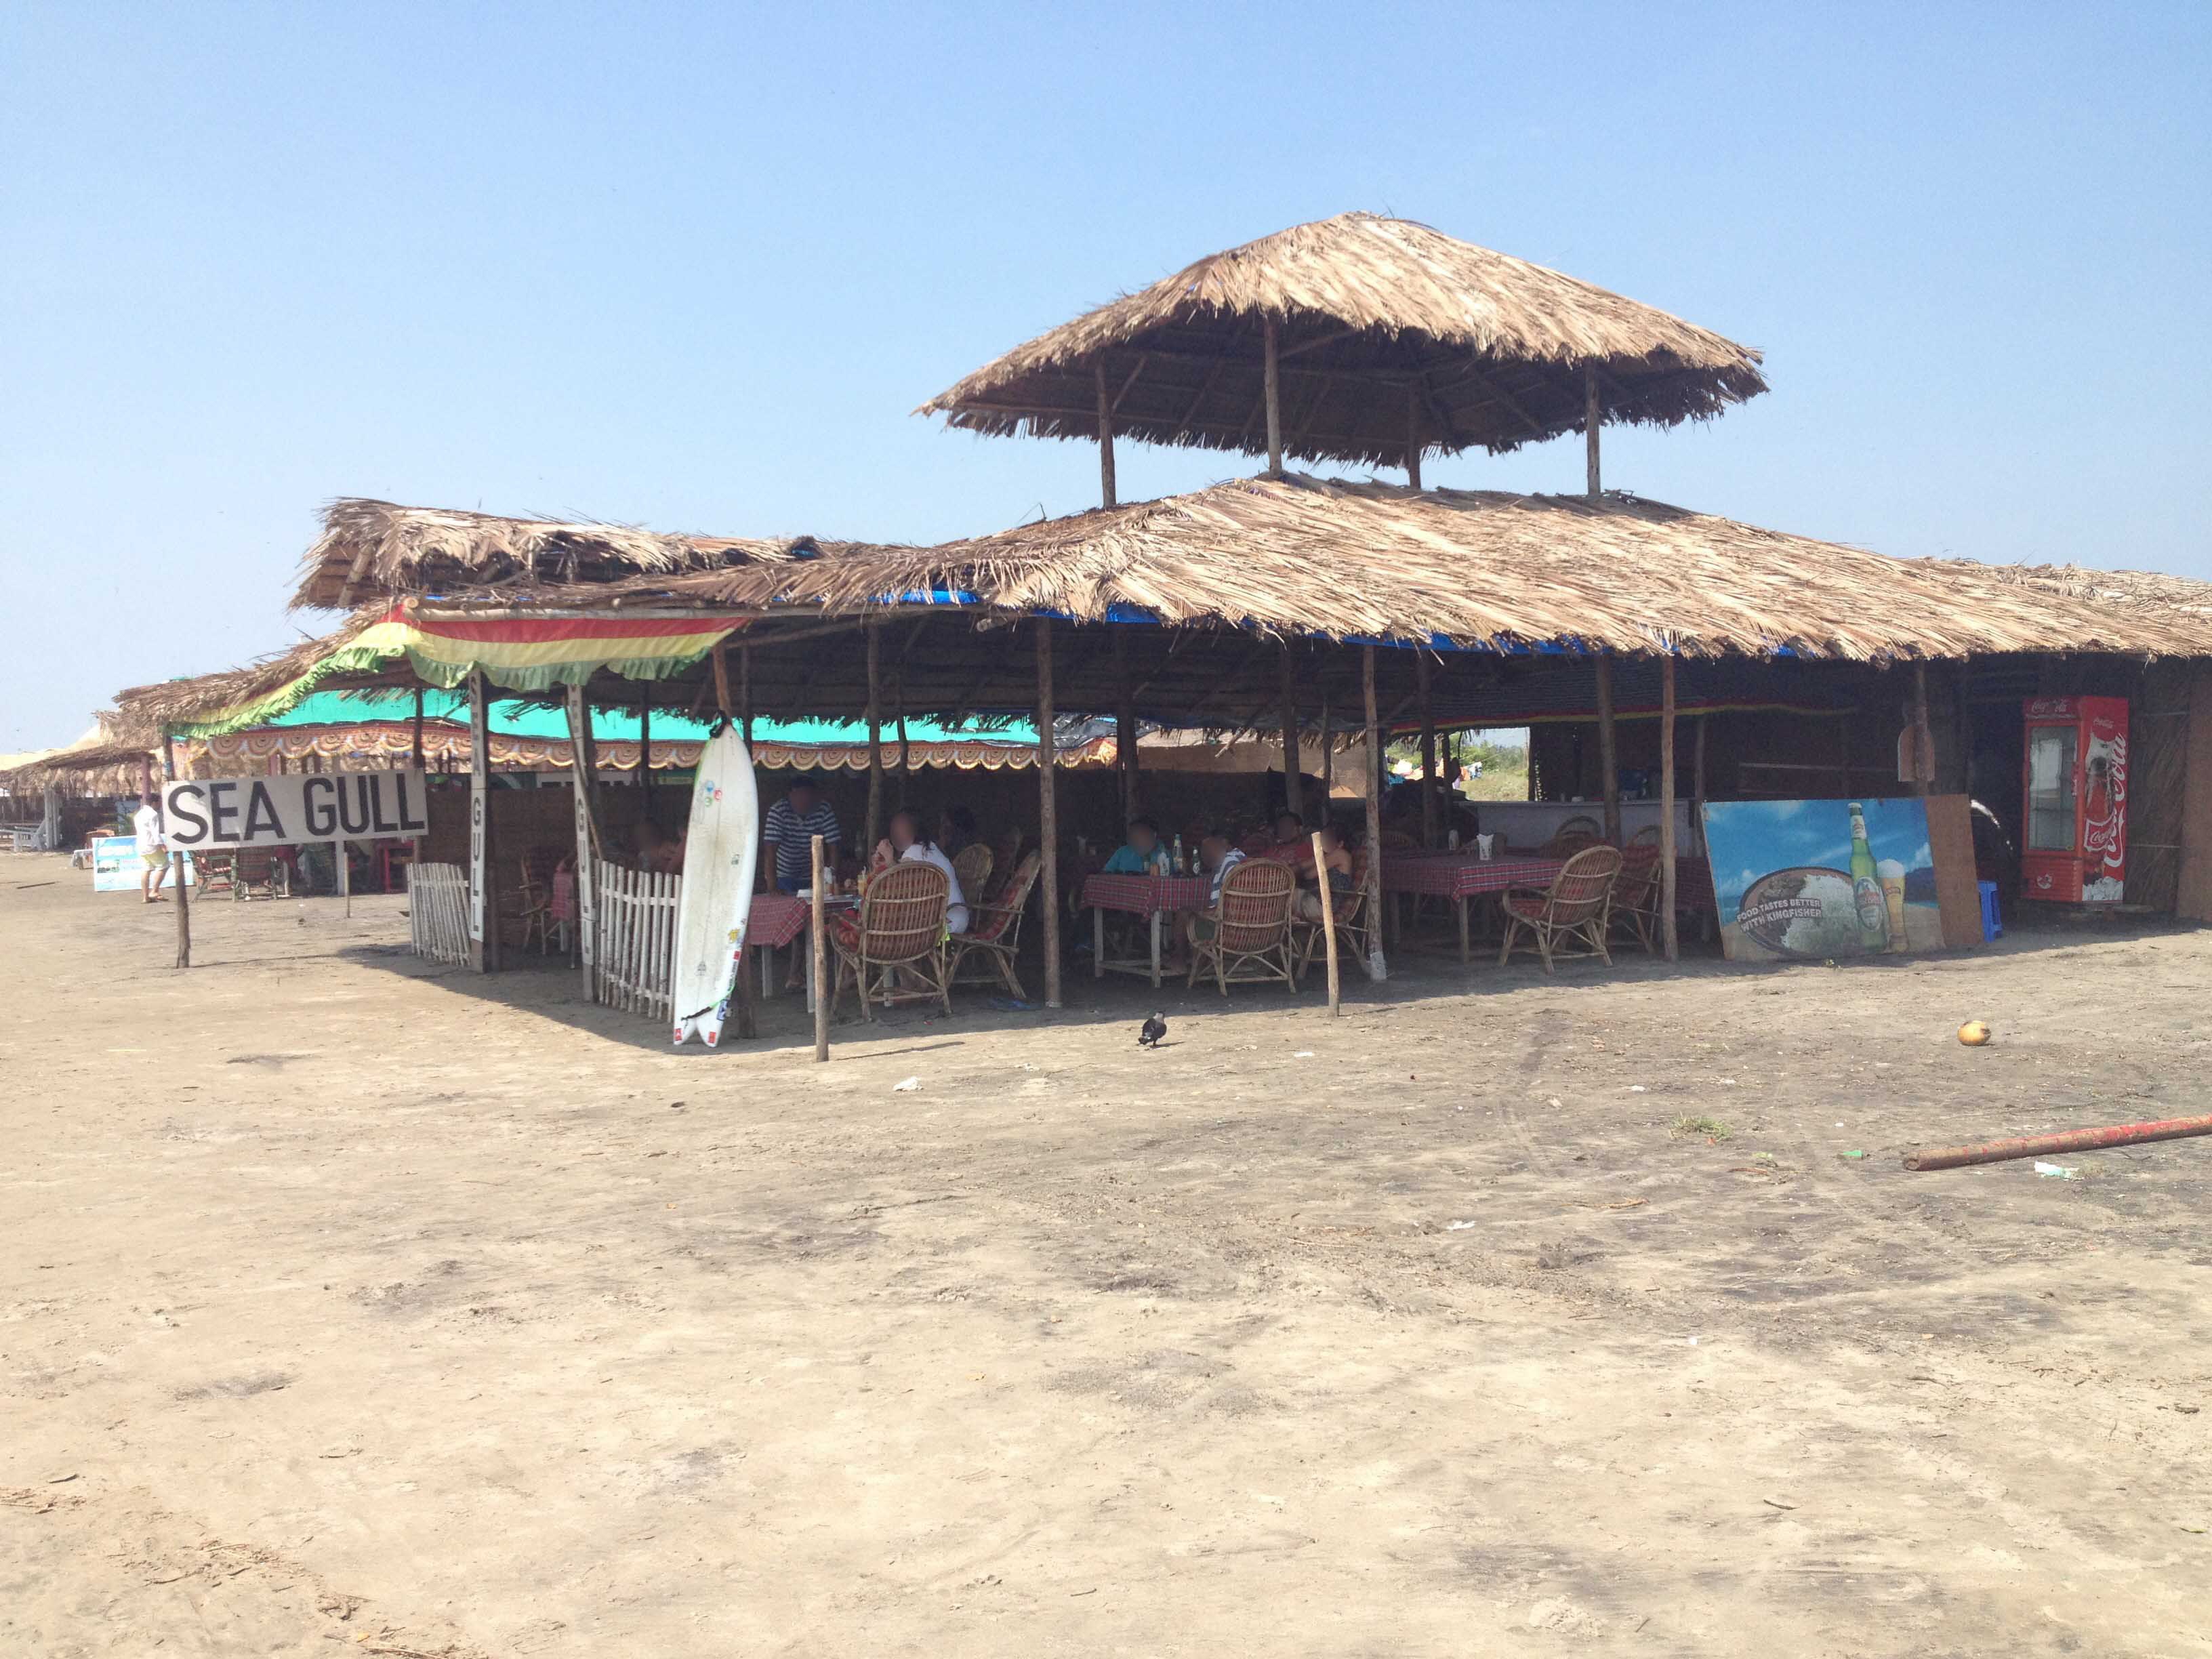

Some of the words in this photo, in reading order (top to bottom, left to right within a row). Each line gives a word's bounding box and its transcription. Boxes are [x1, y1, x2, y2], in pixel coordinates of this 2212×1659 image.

[168, 781, 286, 844] SEA
[303, 773, 426, 837] GULL
[472, 796, 482, 933] GULL
[1737, 907, 1759, 922] FOOD
[1759, 899, 1789, 912] TASTES
[1790, 899, 1821, 907] BETTER
[1740, 915, 1766, 933] WITH
[1766, 909, 1822, 922] KINGFISHER
